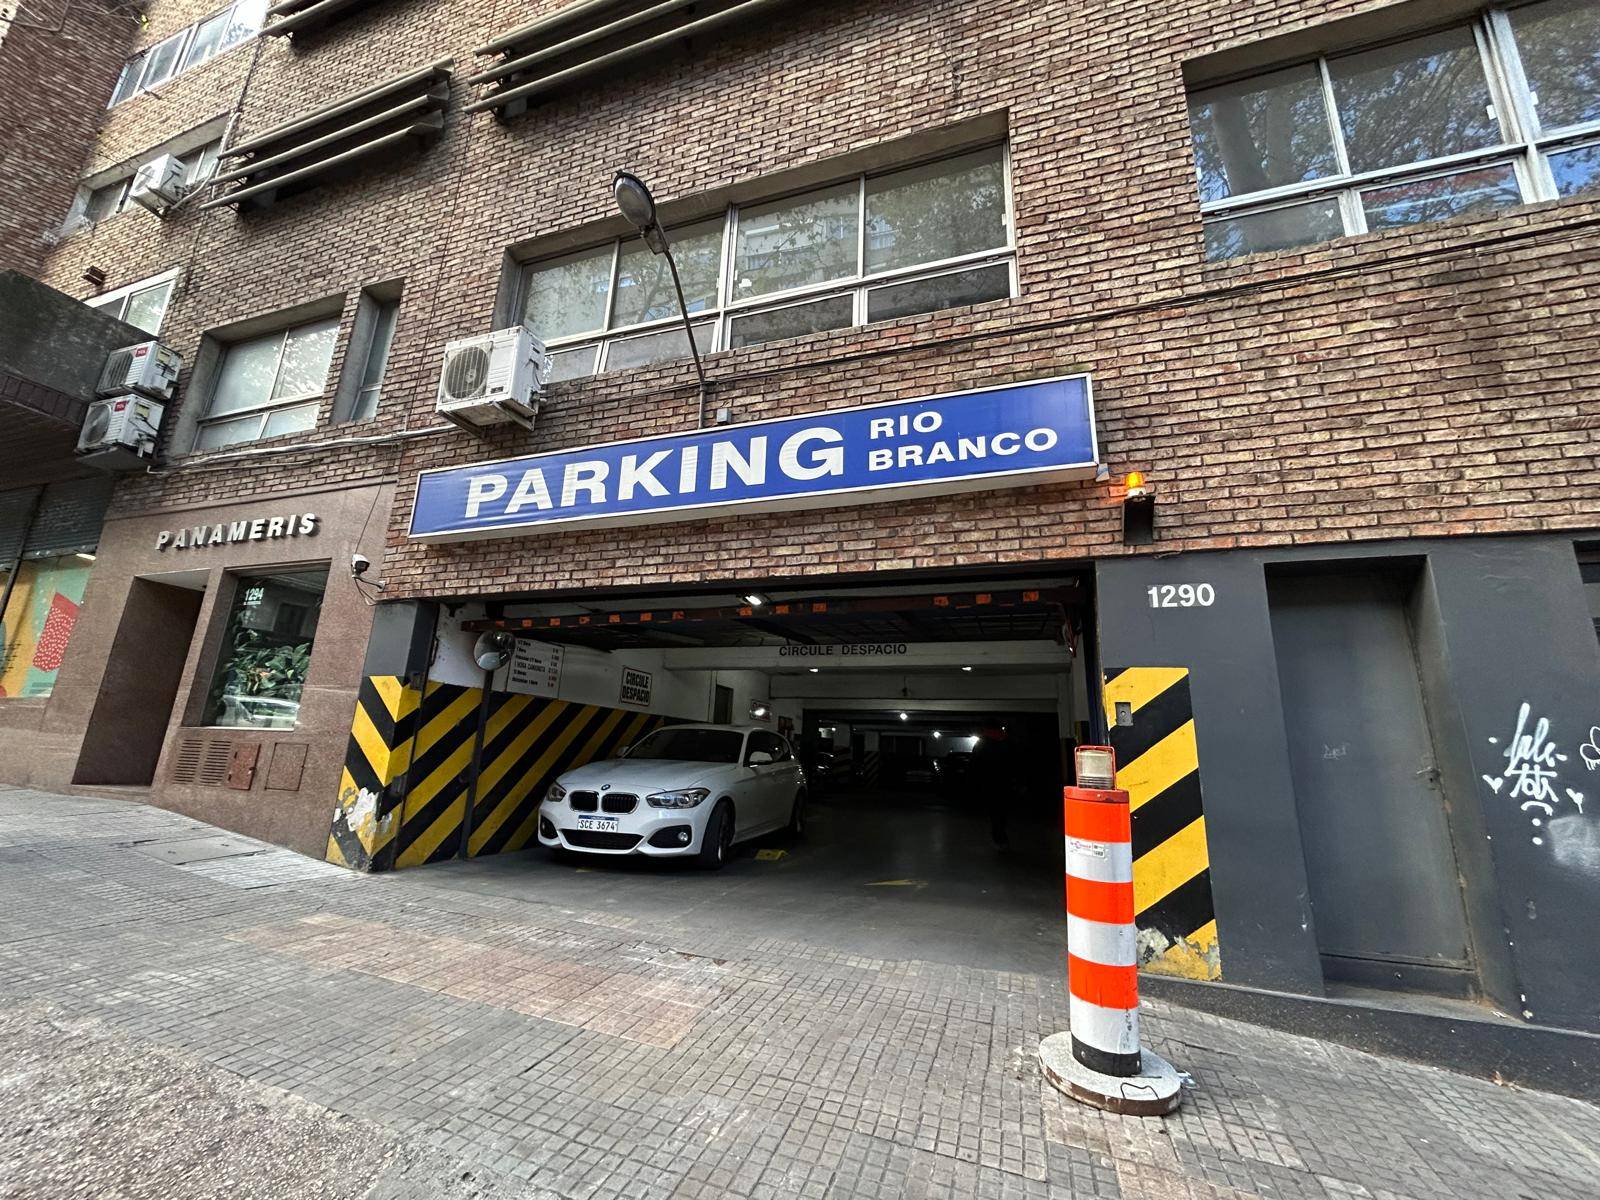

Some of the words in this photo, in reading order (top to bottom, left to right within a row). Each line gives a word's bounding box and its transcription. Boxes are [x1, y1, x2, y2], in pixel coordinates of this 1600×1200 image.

[868, 411, 943, 440] RIO
[867, 427, 1058, 472] BRANCO
[464, 426, 846, 519] PARKING
[155, 512, 317, 550] PANAMERIS
[245, 587, 265, 601] 1294
[1147, 583, 1216, 608] 1290
[779, 645, 834, 657] CIRCULE
[841, 643, 908, 656] DESPACIO
[625, 671, 650, 689] CIRCULE
[621, 685, 650, 702] DESPACIO
[580, 820, 593, 829] SCE
